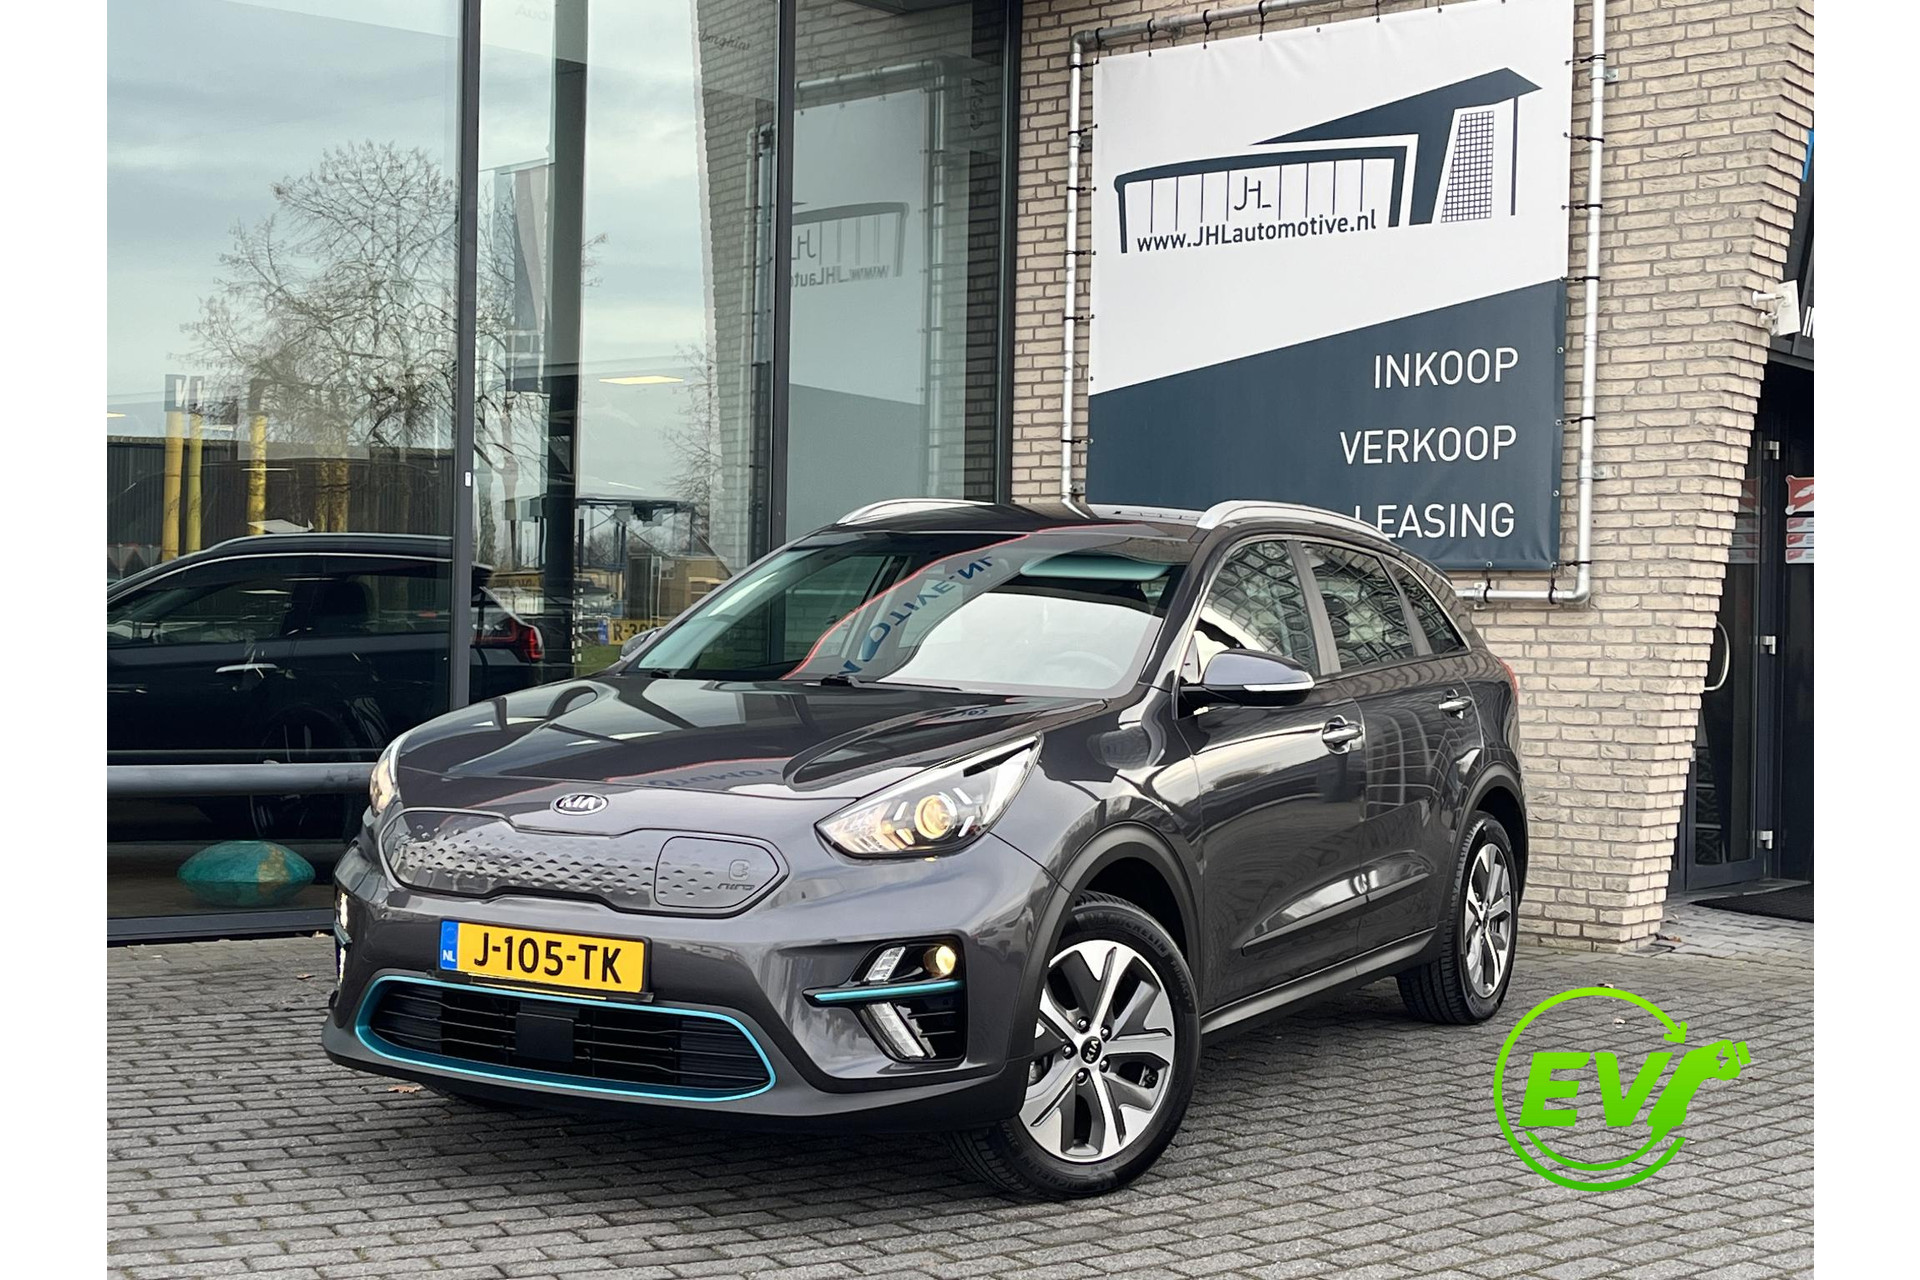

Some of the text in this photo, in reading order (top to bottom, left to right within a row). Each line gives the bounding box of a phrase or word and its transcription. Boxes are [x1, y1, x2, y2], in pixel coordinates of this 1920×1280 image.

[1233, 176, 1272, 211] JHL
[1137, 209, 1376, 252] www.JHLautomotive.nl
[1374, 347, 1519, 389] INKOOP
[1339, 425, 1517, 465] VERKOOP
[556, 794, 602, 812] KIA
[442, 949, 456, 963] NL
[474, 932, 622, 984] J-105-TK
[1085, 1040, 1100, 1062] KIA
